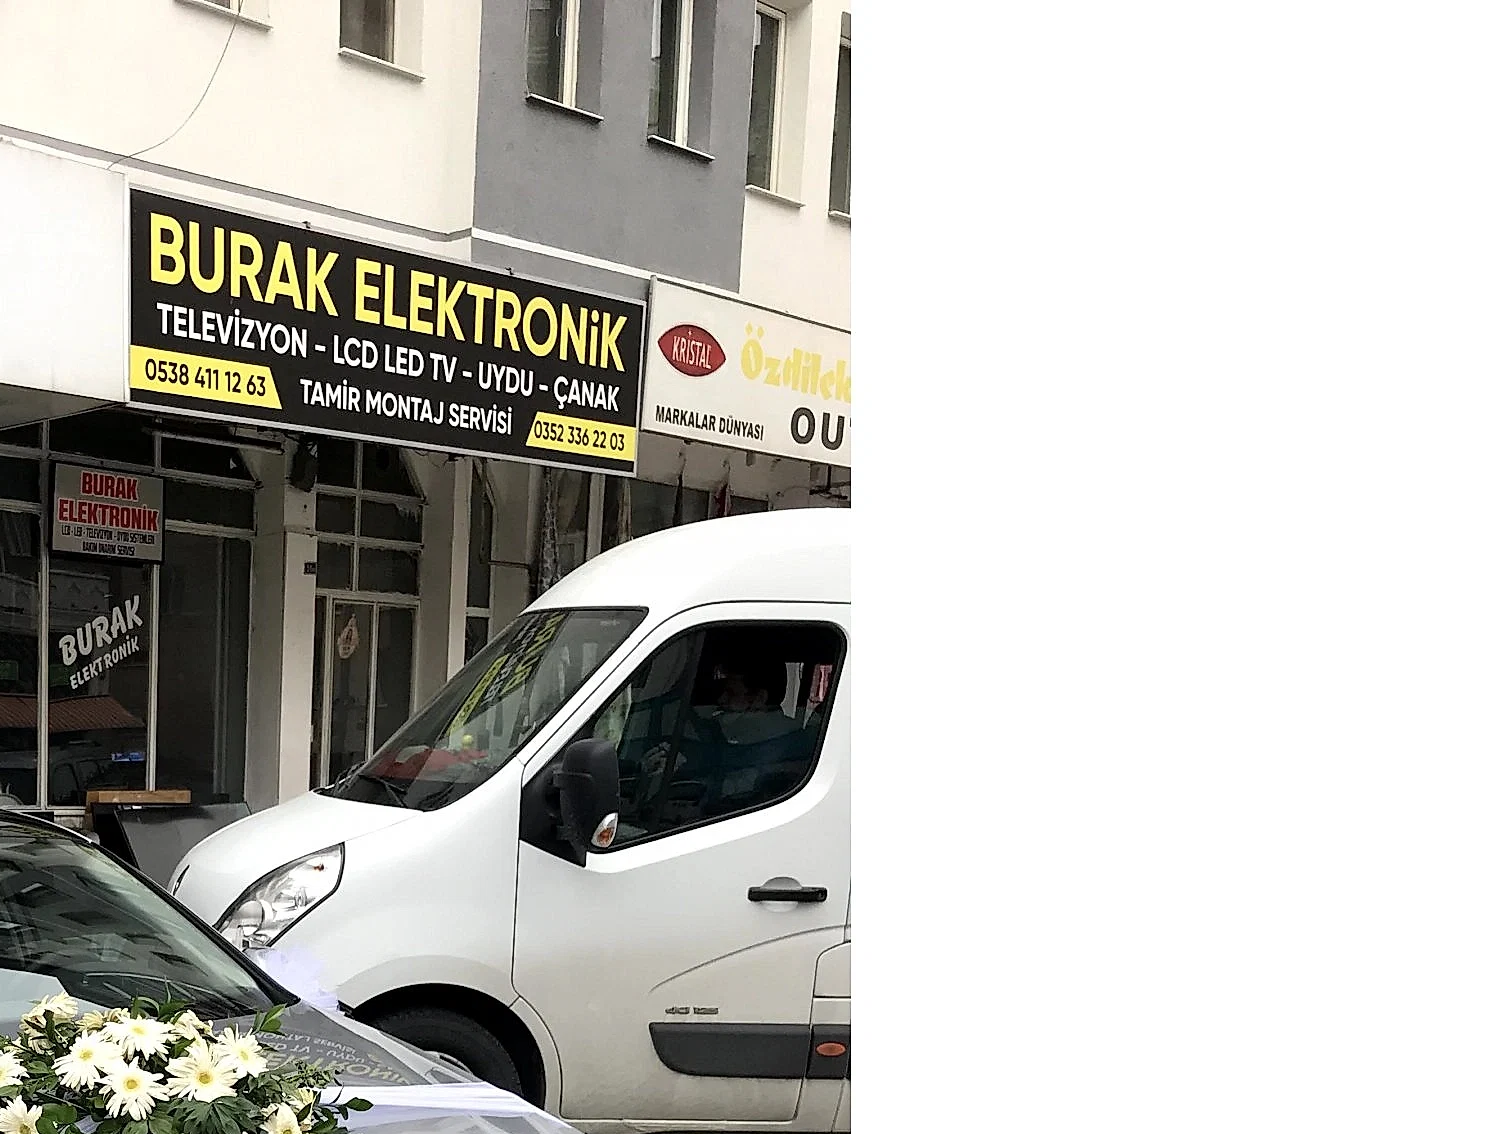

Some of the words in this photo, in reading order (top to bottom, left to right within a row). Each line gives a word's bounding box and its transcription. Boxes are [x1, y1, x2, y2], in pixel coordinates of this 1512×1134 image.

[149, 212, 339, 317] BURAK
[354, 258, 628, 372] ELEKTRONİK
[145, 358, 189, 386] 0538
[194, 366, 219, 391] 411
[224, 371, 241, 394] 12
[246, 374, 266, 397] 63
[156, 302, 308, 358] TELEVİZYON
[333, 335, 378, 370] LCD
[384, 344, 424, 378] LED
[429, 355, 457, 383] TV
[478, 361, 534, 396] UYDU
[553, 375, 620, 412] ÇANAK
[300, 377, 361, 413] TAMİR
[366, 391, 445, 425] MONTAJ
[448, 402, 513, 436] SERVİSİ
[655, 404, 716, 432] MARKALAR
[719, 414, 764, 441] DÜNYASI
[534, 420, 564, 444] 0352
[567, 424, 589, 446] 336
[592, 429, 608, 448] 22
[610, 431, 625, 452] 03
[790, 407, 851, 451] OU
[81, 471, 139, 501] BURAK
[58, 497, 159, 533] ELEKTRONİK
[58, 595, 143, 666] BURAK
[69, 635, 140, 690] ELEKTRONİK
